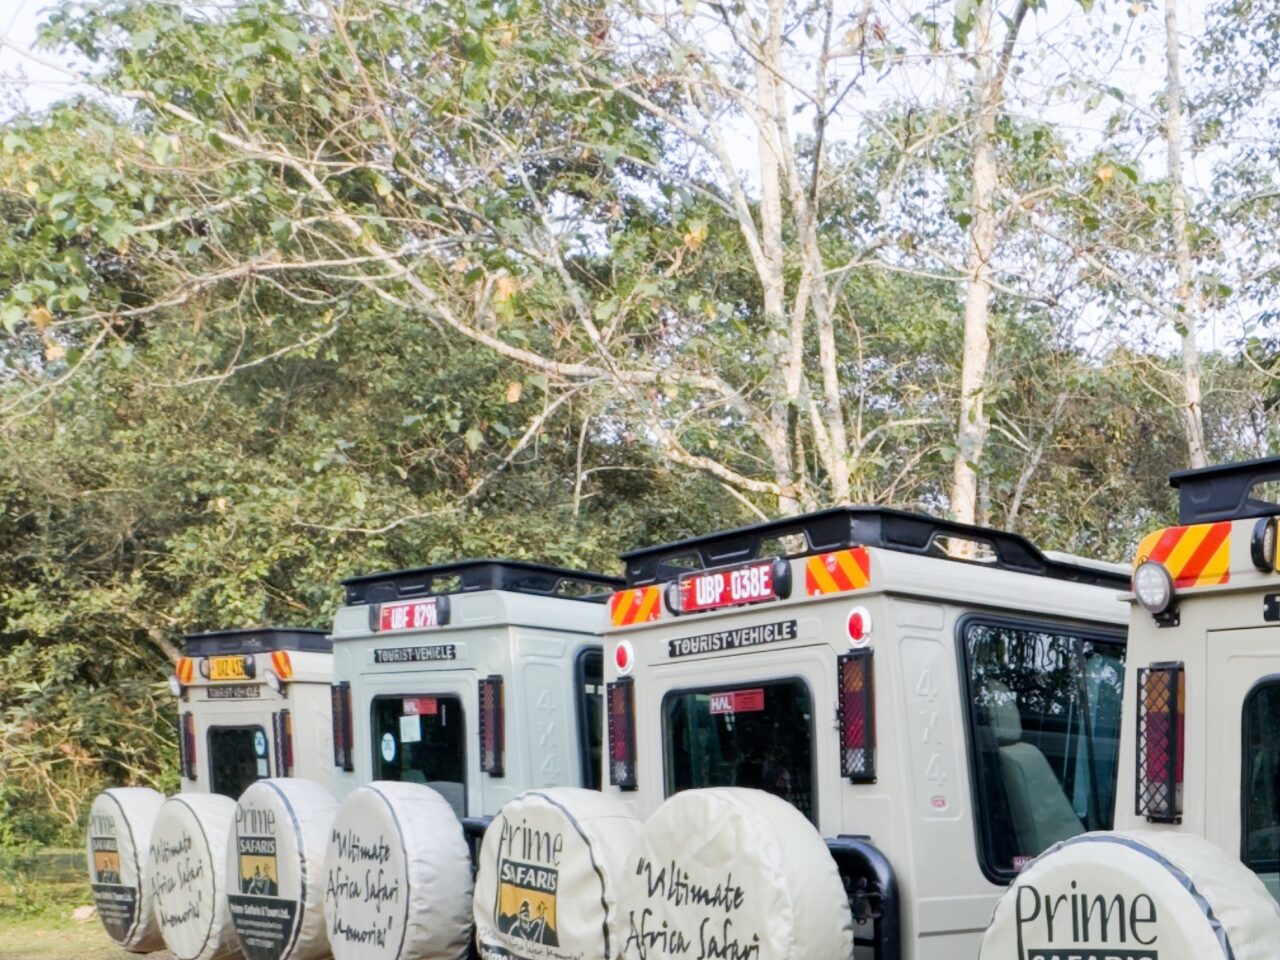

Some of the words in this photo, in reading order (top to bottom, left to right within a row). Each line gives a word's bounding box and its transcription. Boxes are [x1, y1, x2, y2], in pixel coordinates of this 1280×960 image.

[696, 574, 725, 606] UBP
[731, 564, 772, 600] 038E
[415, 645, 454, 661] VEHICLE
[673, 635, 730, 656] TOURIST
[732, 622, 792, 647] VEHICLE
[236, 802, 276, 836] Prime
[239, 838, 276, 854] SAFARIS
[498, 815, 563, 866] Prime
[326, 866, 362, 909] Africa
[364, 868, 399, 914] Safari
[501, 863, 558, 892] SAFARIS
